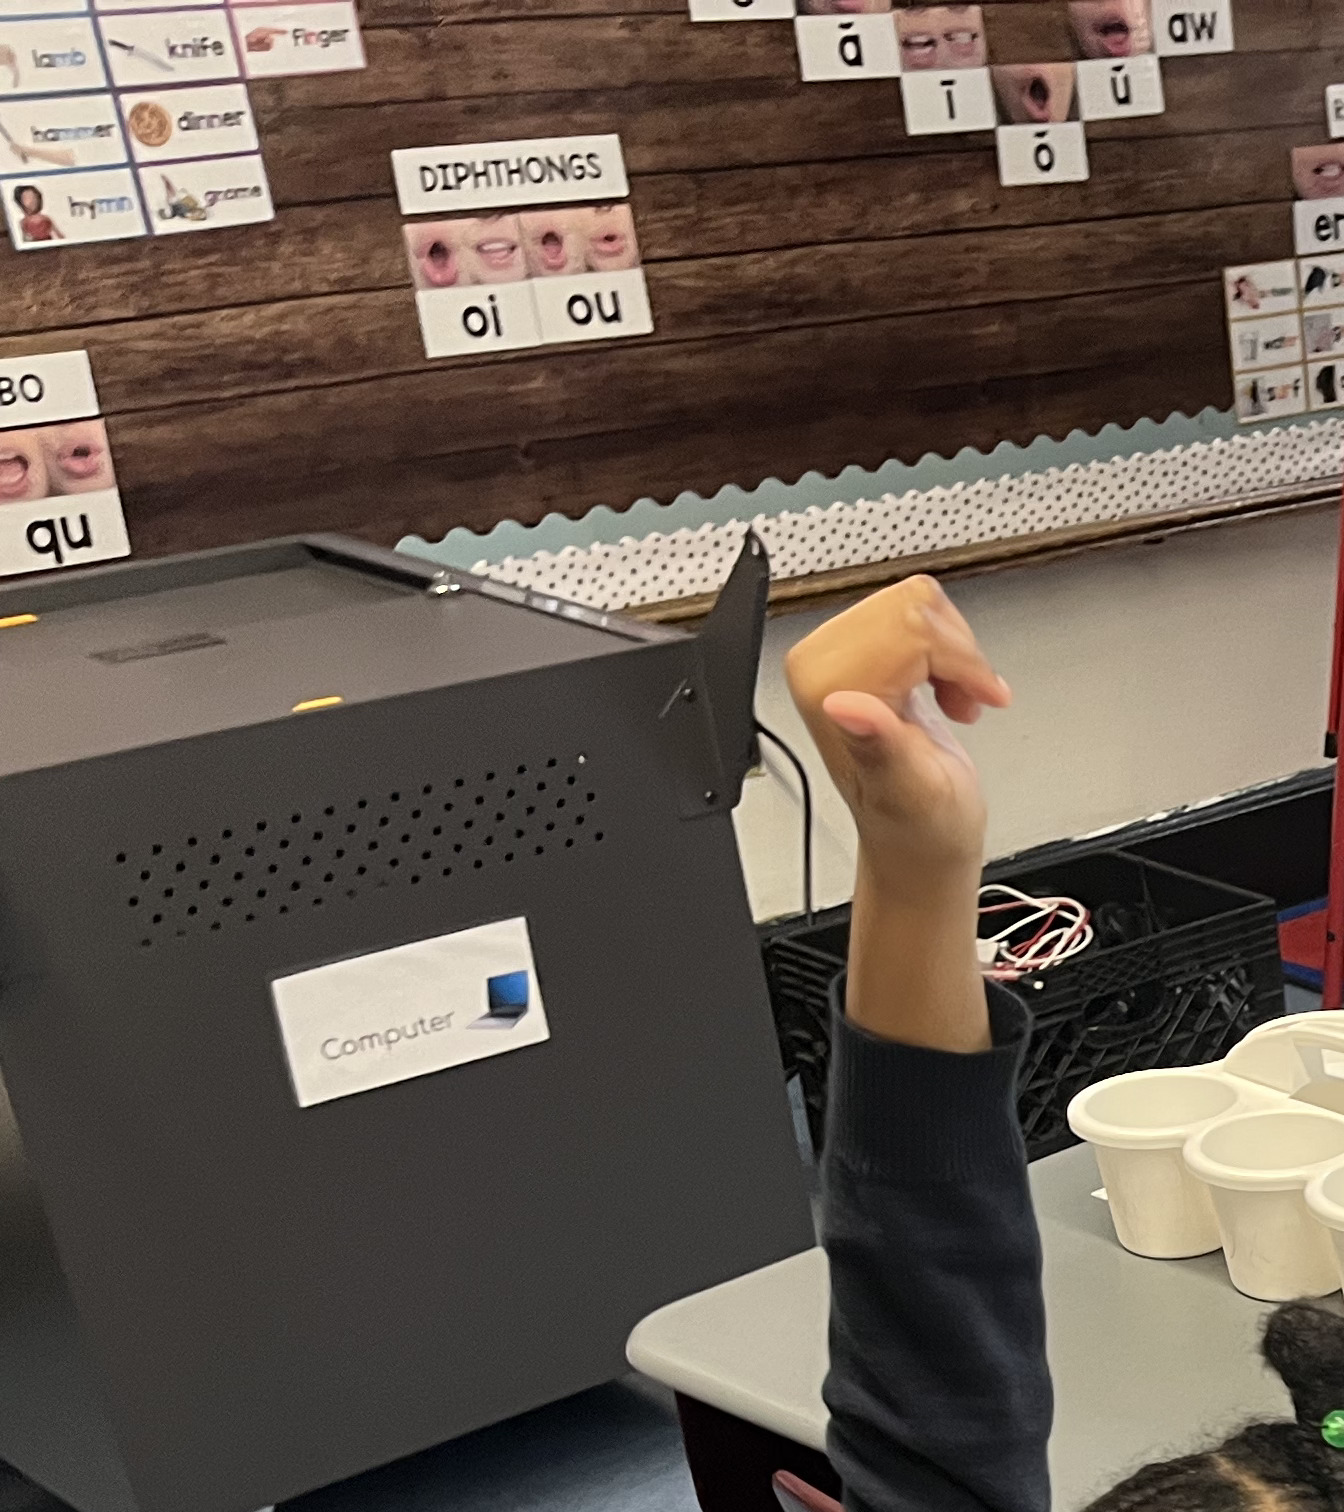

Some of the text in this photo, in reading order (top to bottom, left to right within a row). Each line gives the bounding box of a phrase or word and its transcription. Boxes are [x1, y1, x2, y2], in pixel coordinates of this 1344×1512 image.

[292, 28, 349, 48] finger
[1168, 12, 1217, 44] aw
[32, 48, 87, 69] lamb
[165, 37, 225, 59] knife
[31, 122, 115, 143] hammer
[177, 110, 246, 132] dinner
[418, 152, 602, 192] DIPHTHONGS
[67, 196, 134, 219] hymn
[461, 294, 503, 338] oi
[566, 291, 622, 326] ou
[26, 513, 93, 564] qu
[319, 1008, 456, 1063] Computer
